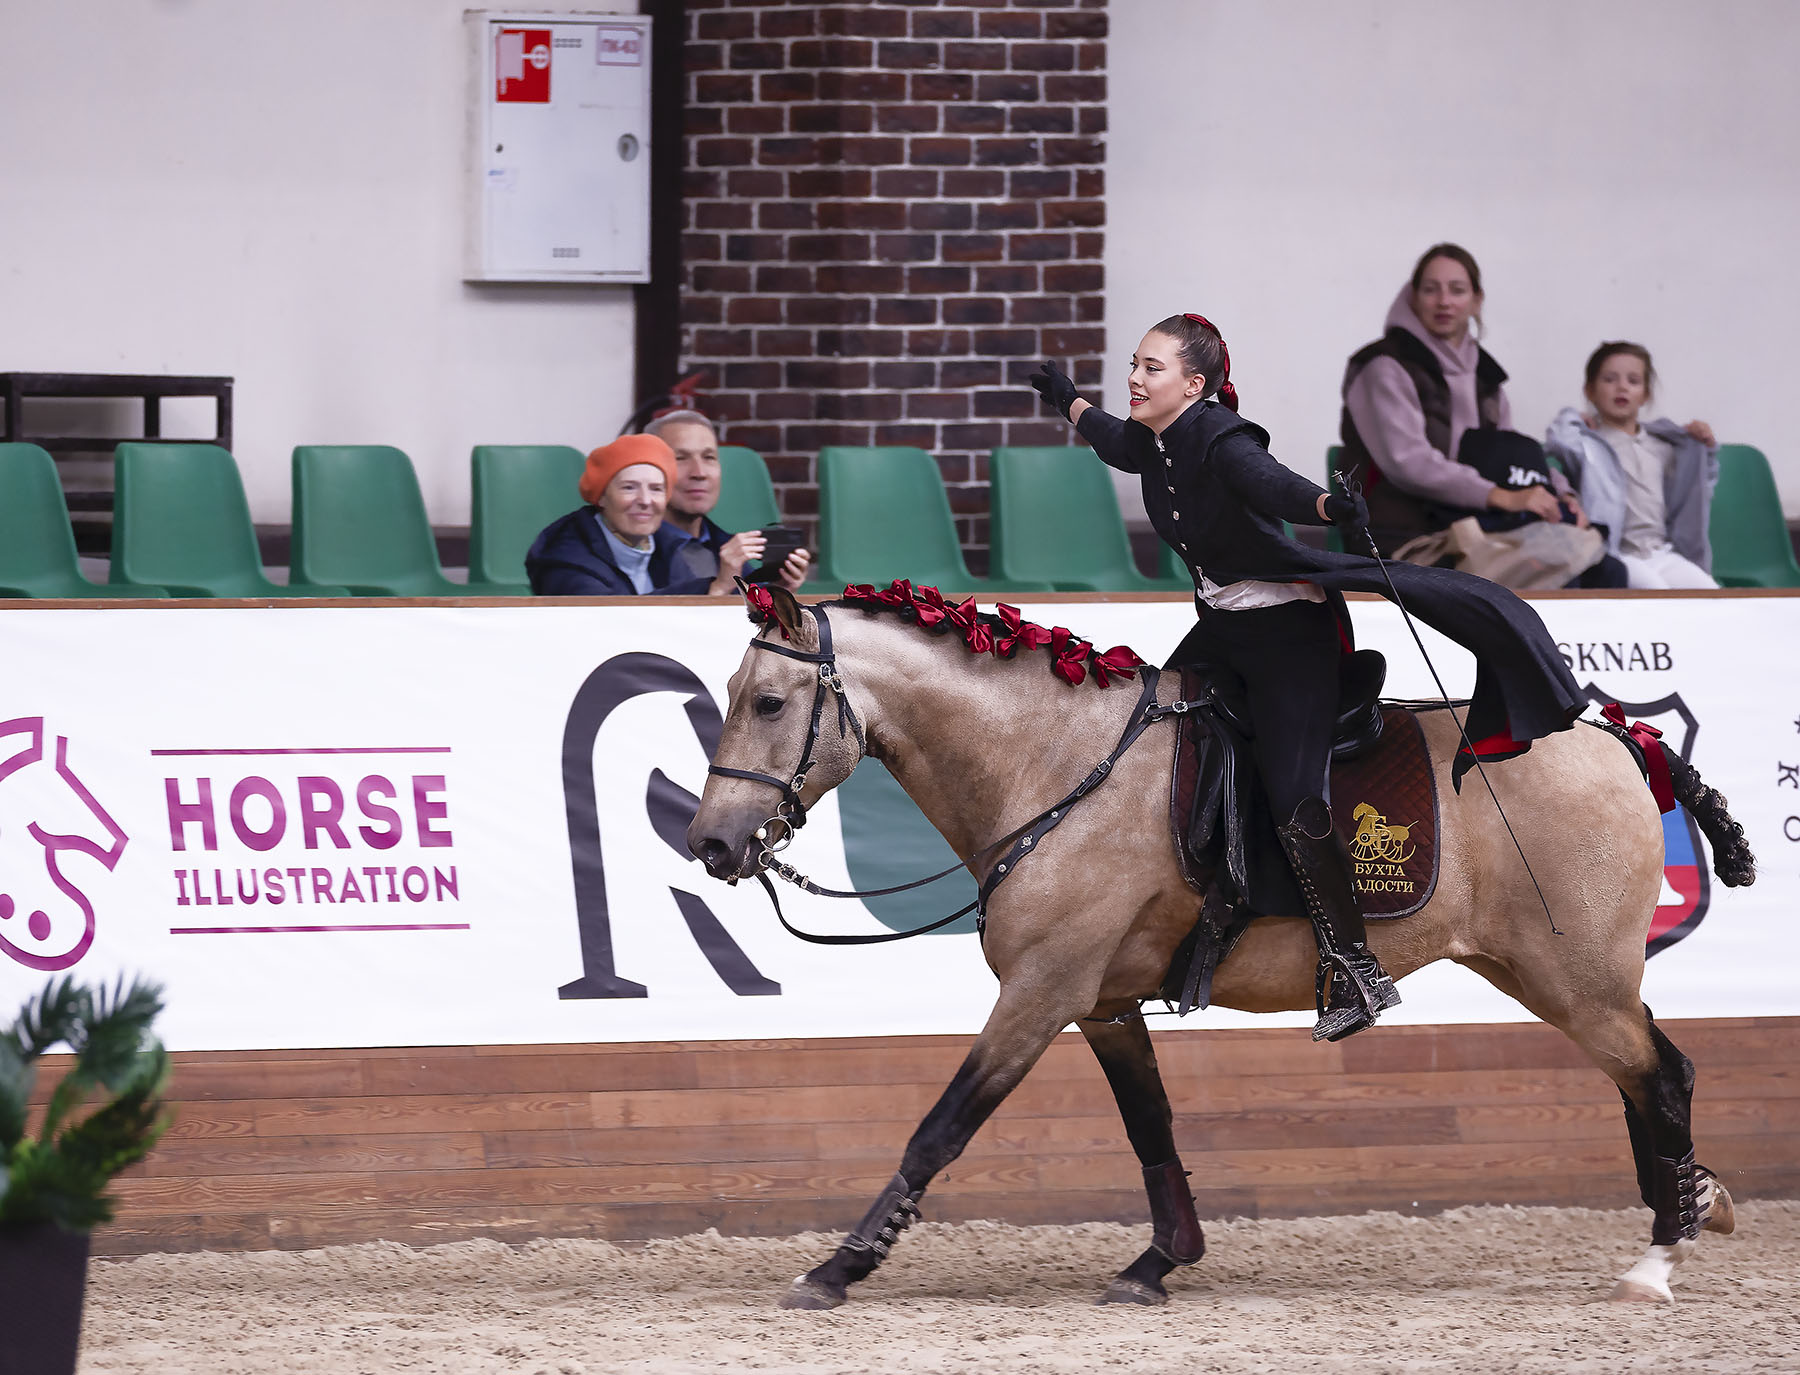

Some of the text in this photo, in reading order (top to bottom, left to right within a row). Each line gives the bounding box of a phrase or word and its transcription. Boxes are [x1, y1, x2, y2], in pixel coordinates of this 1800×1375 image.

[164, 774, 453, 852] HORSE
[1354, 862, 1406, 876] БУХТА
[174, 865, 459, 905] ILLUSTRATION
[1355, 879, 1415, 894] АДОСТИ
